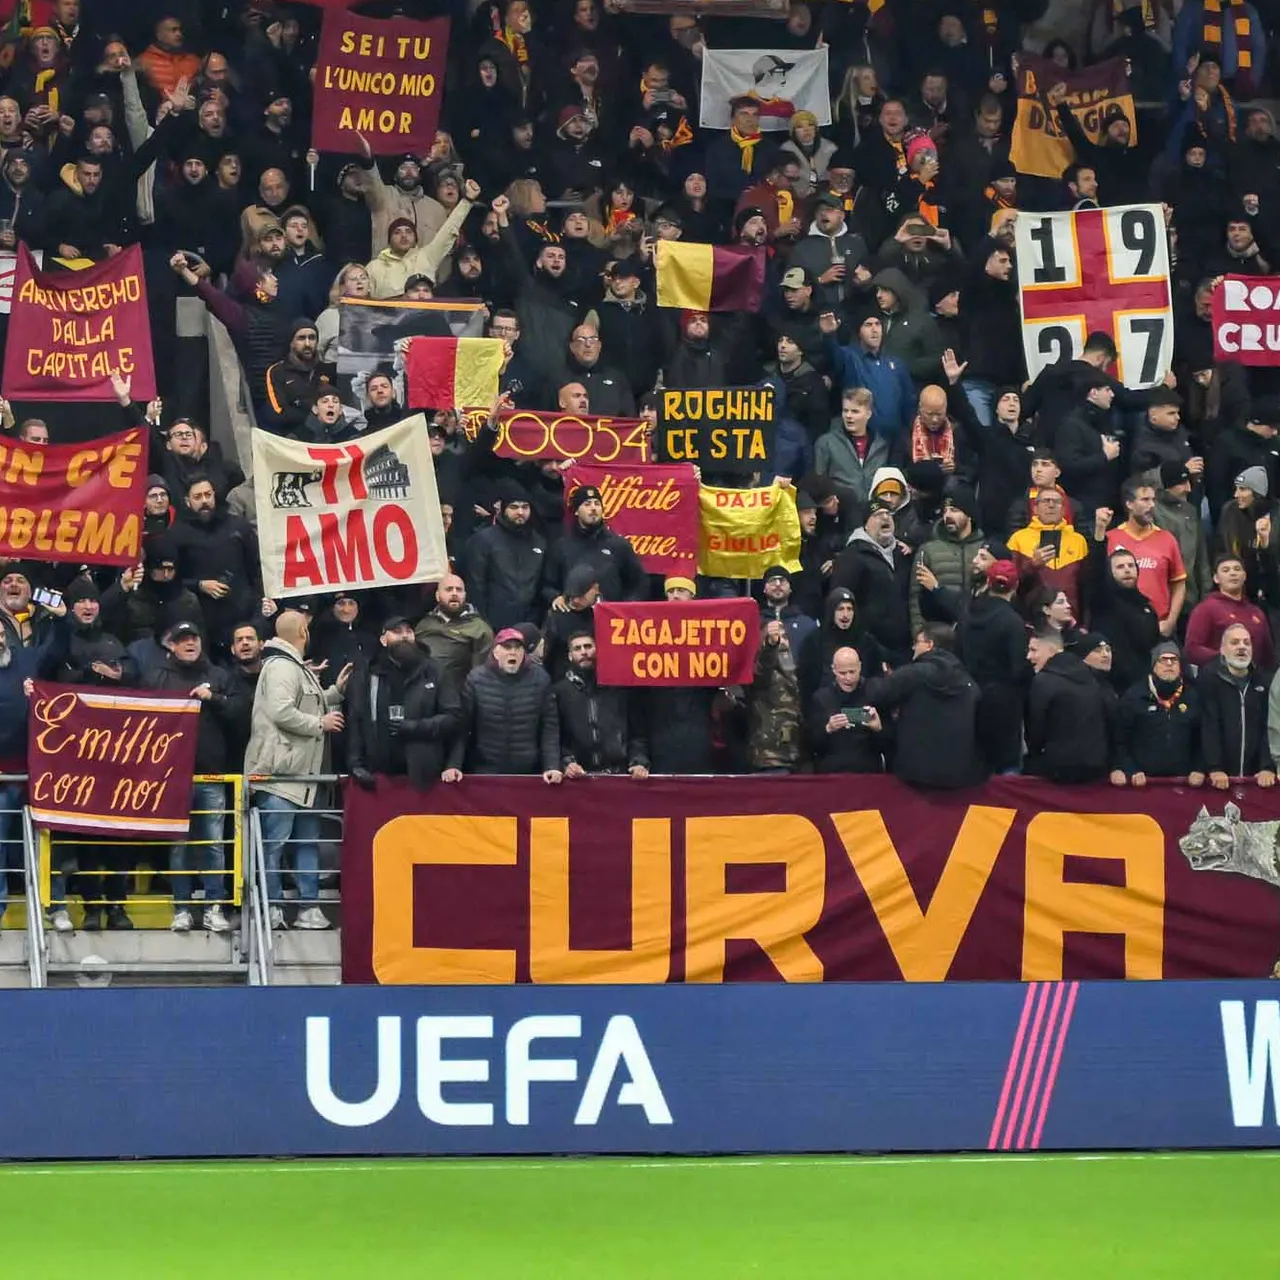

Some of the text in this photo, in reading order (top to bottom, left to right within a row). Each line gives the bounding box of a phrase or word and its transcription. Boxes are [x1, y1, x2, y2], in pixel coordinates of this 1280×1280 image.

[340, 31, 431, 60] SEI TU
[324, 65, 435, 98] L'UNICO MIO
[338, 106, 412, 134] AMOR
[52, 315, 114, 345] DALLA
[27, 347, 135, 378] CAPITALE
[493, 412, 648, 464] 0054
[666, 427, 767, 460] CE STA
[306, 443, 369, 506] TI
[715, 490, 772, 509] DAJE
[283, 502, 420, 588] AMO
[707, 532, 780, 554] GIULIO
[610, 618, 746, 646] ZAGAJETTO
[632, 650, 730, 679] CON NOI
[34, 691, 184, 765] Emilio
[33, 766, 174, 813] con noi
[371, 804, 1165, 986] CURVA
[305, 1013, 674, 1128] UEFA
